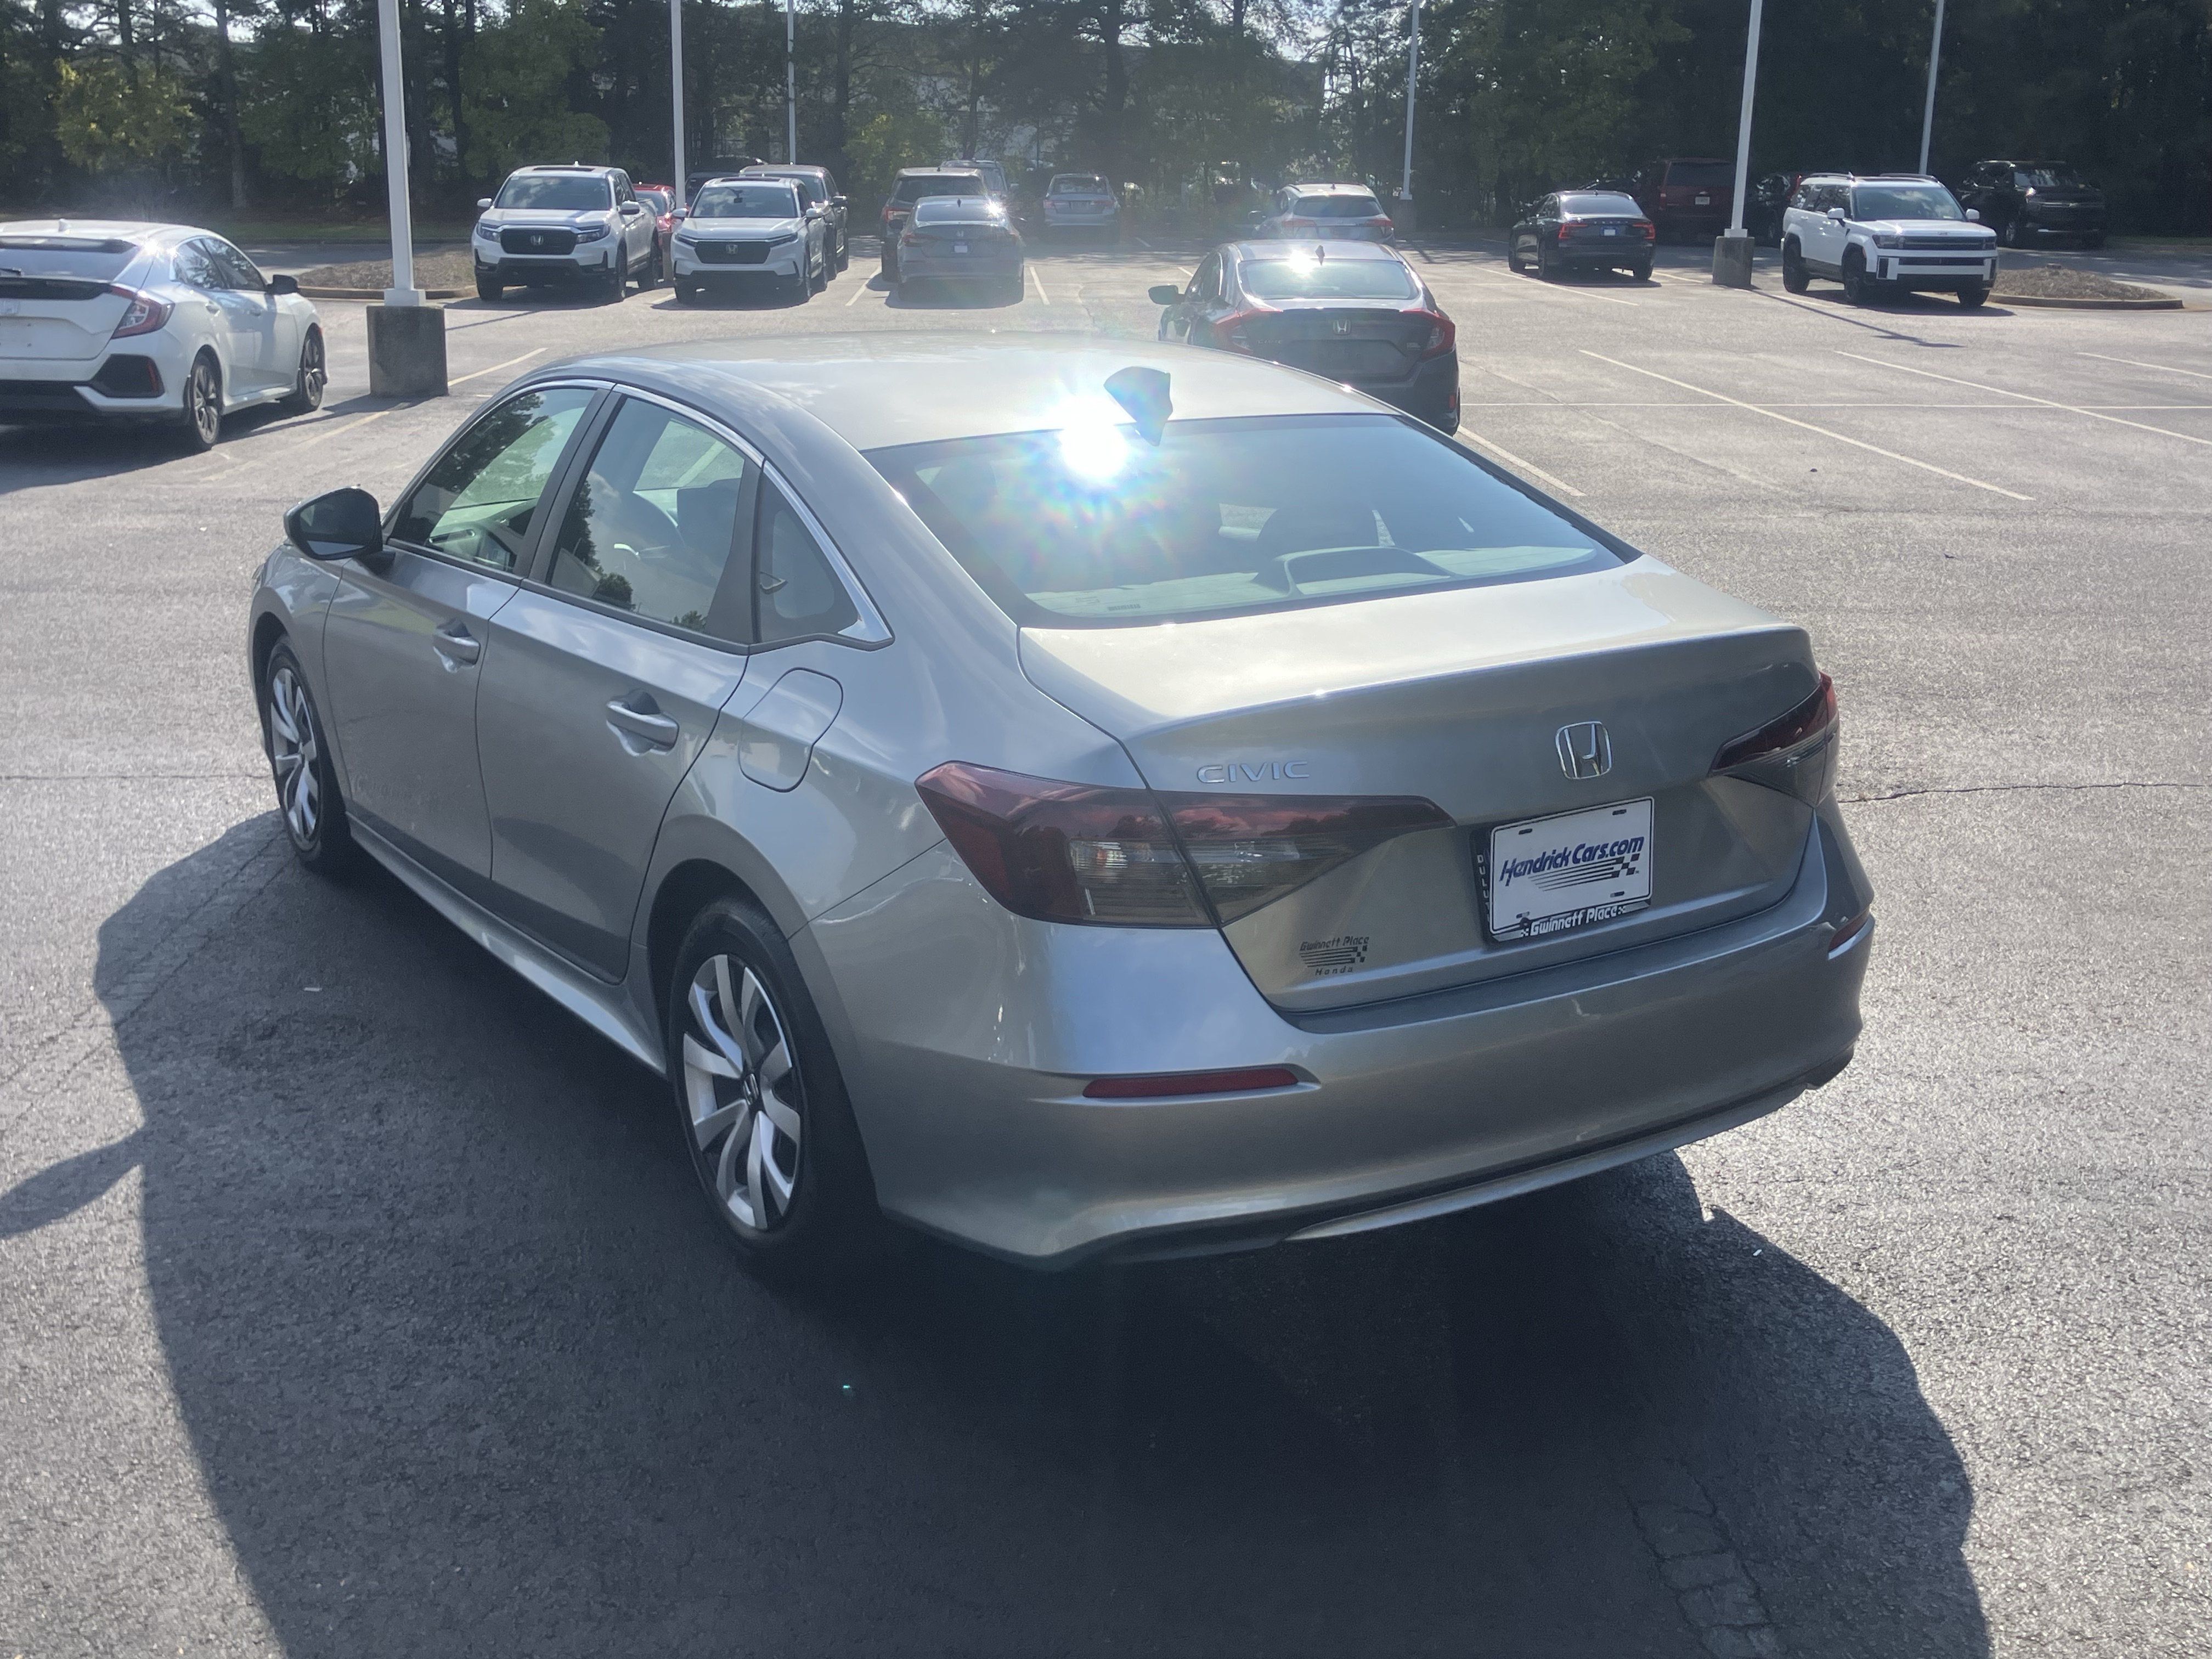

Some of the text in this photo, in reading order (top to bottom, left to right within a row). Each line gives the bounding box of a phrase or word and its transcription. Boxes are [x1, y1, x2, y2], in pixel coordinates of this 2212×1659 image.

[1197, 760, 1310, 783] CIVIC
[1530, 906, 1617, 936] Gwinnett Place
[1299, 936, 1370, 951] Gwinnett Place
[1315, 966, 1353, 975] Honda
